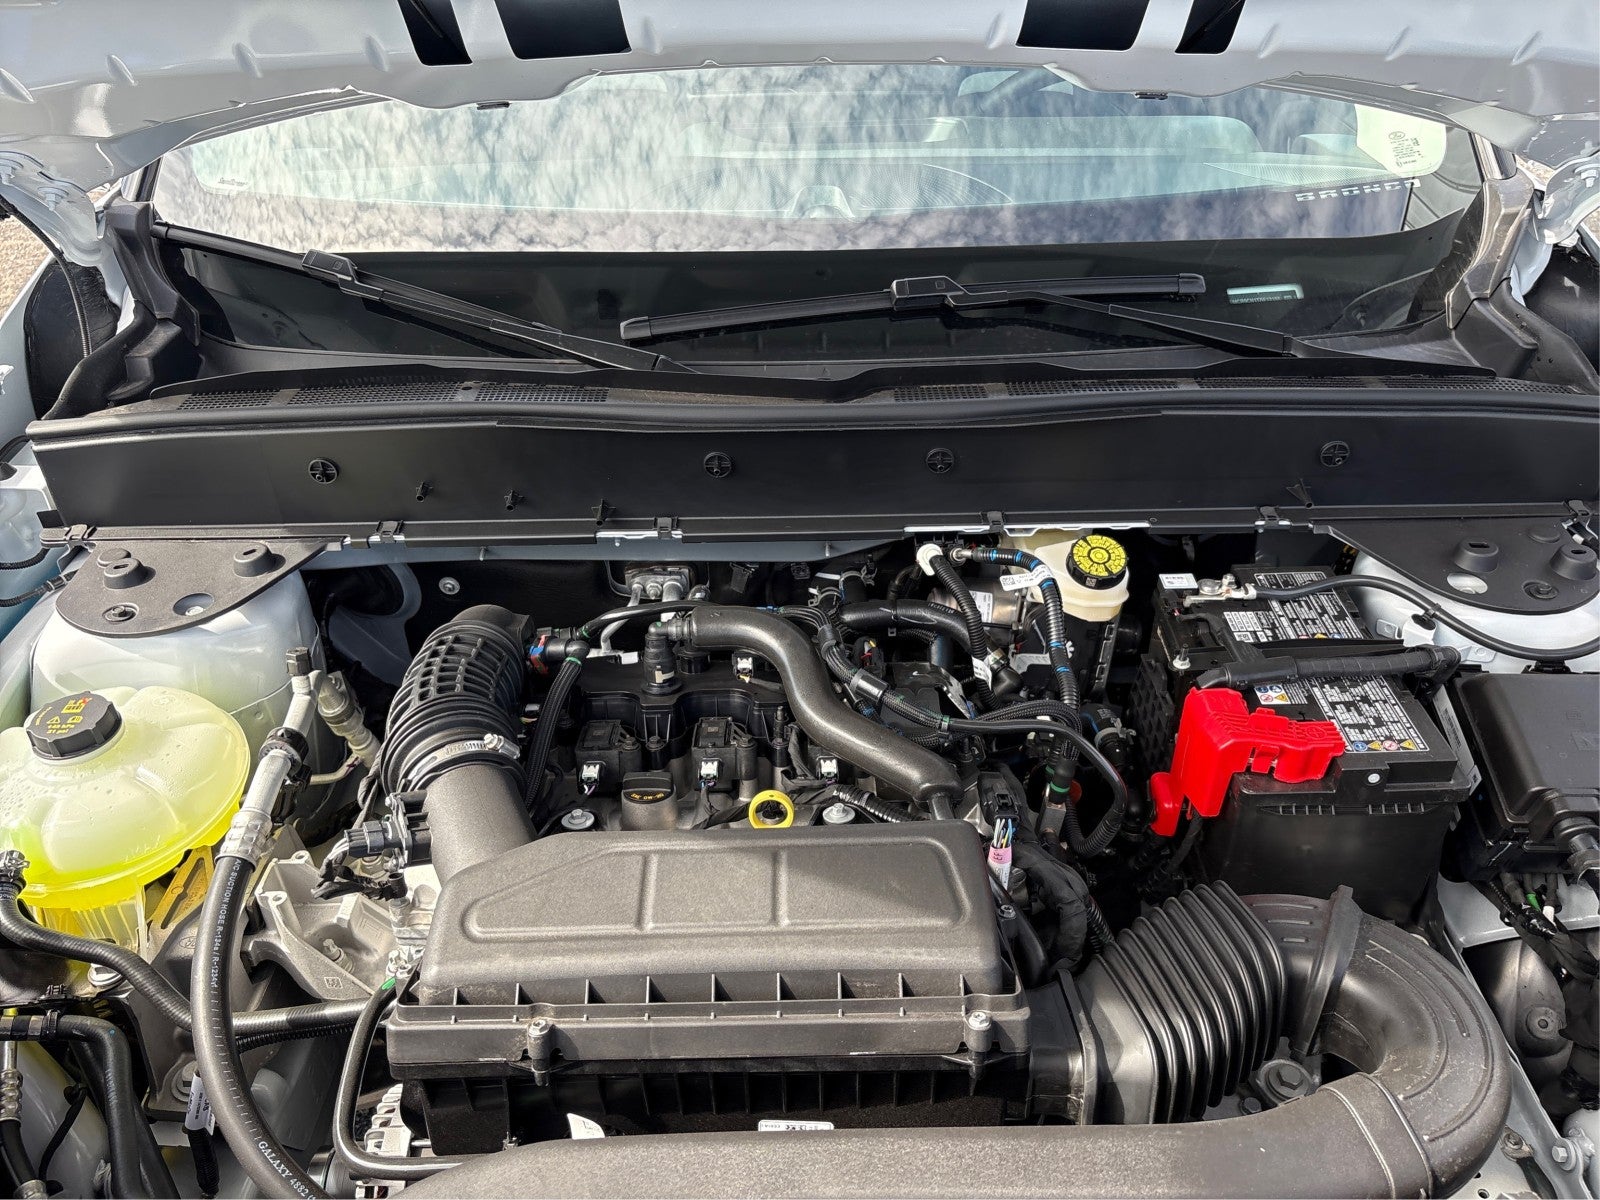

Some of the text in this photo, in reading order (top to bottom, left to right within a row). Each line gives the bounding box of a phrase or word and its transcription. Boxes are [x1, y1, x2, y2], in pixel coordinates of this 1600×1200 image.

[1295, 179, 1421, 202] BRONCO
[223, 872, 238, 902] SUCTION
[218, 904, 228, 925] HOSE
[258, 1141, 309, 1197] GALAXY 4882
